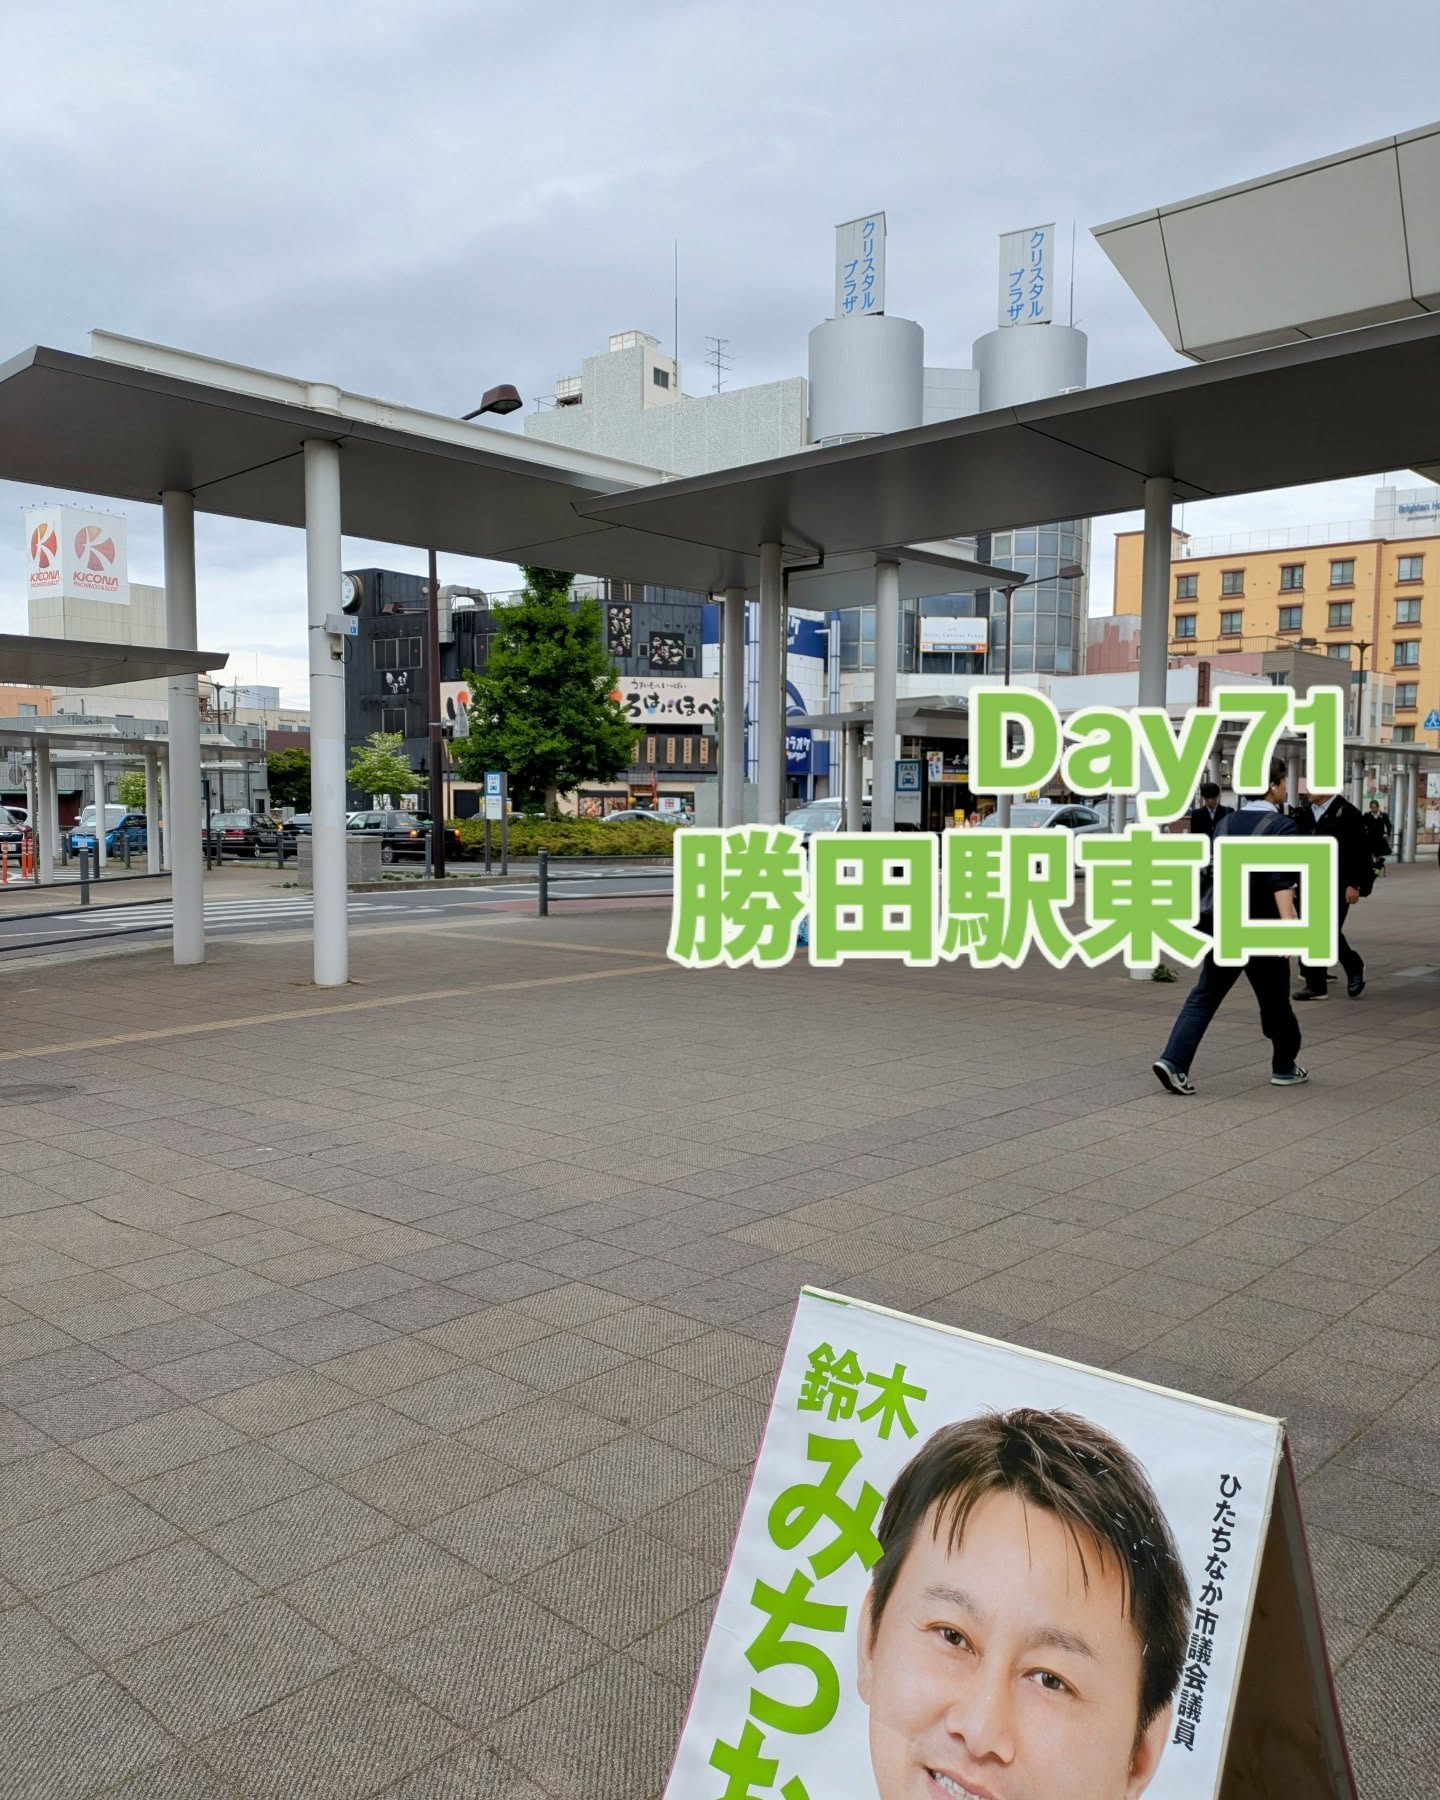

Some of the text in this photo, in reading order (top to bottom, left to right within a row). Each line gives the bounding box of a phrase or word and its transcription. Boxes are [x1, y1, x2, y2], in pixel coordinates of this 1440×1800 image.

[842, 259, 858, 314] プラザ
[861, 220, 876, 310] クリスタル
[1028, 231, 1045, 319] クリスタル
[1007, 268, 1025, 322] プラザ
[30, 570, 60, 582] KICONA
[73, 571, 119, 587] KICONA
[900, 764, 917, 772] TAXI
[797, 1341, 928, 1440] 鈴木
[1171, 1473, 1243, 1752] ひたちなか市議会議員
